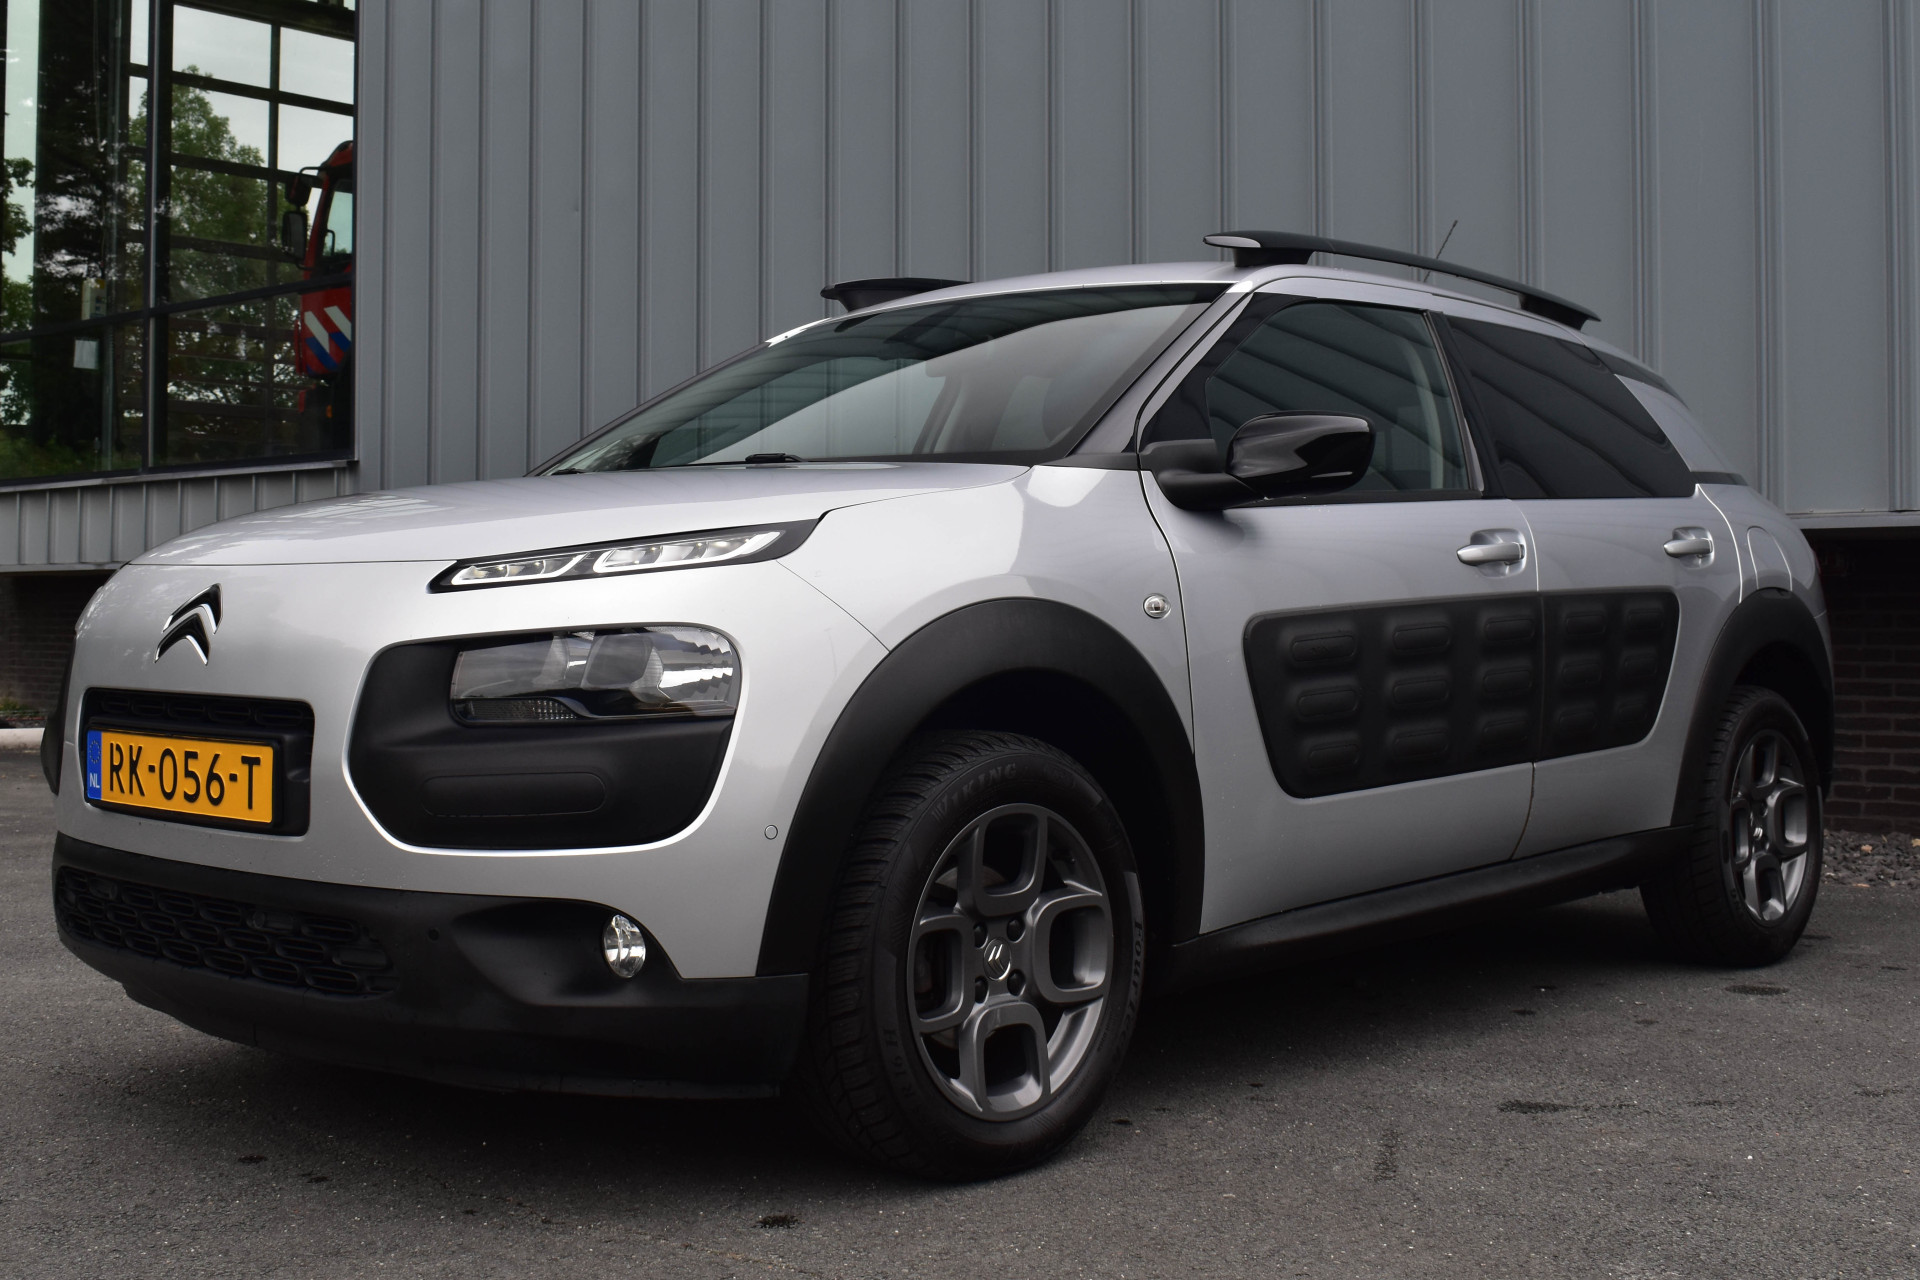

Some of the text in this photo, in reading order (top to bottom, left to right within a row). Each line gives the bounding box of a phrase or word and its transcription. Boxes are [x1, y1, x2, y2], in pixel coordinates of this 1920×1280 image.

[90, 773, 100, 788] NL
[109, 742, 261, 810] RK-056-T
[932, 763, 1016, 820] VIKING
